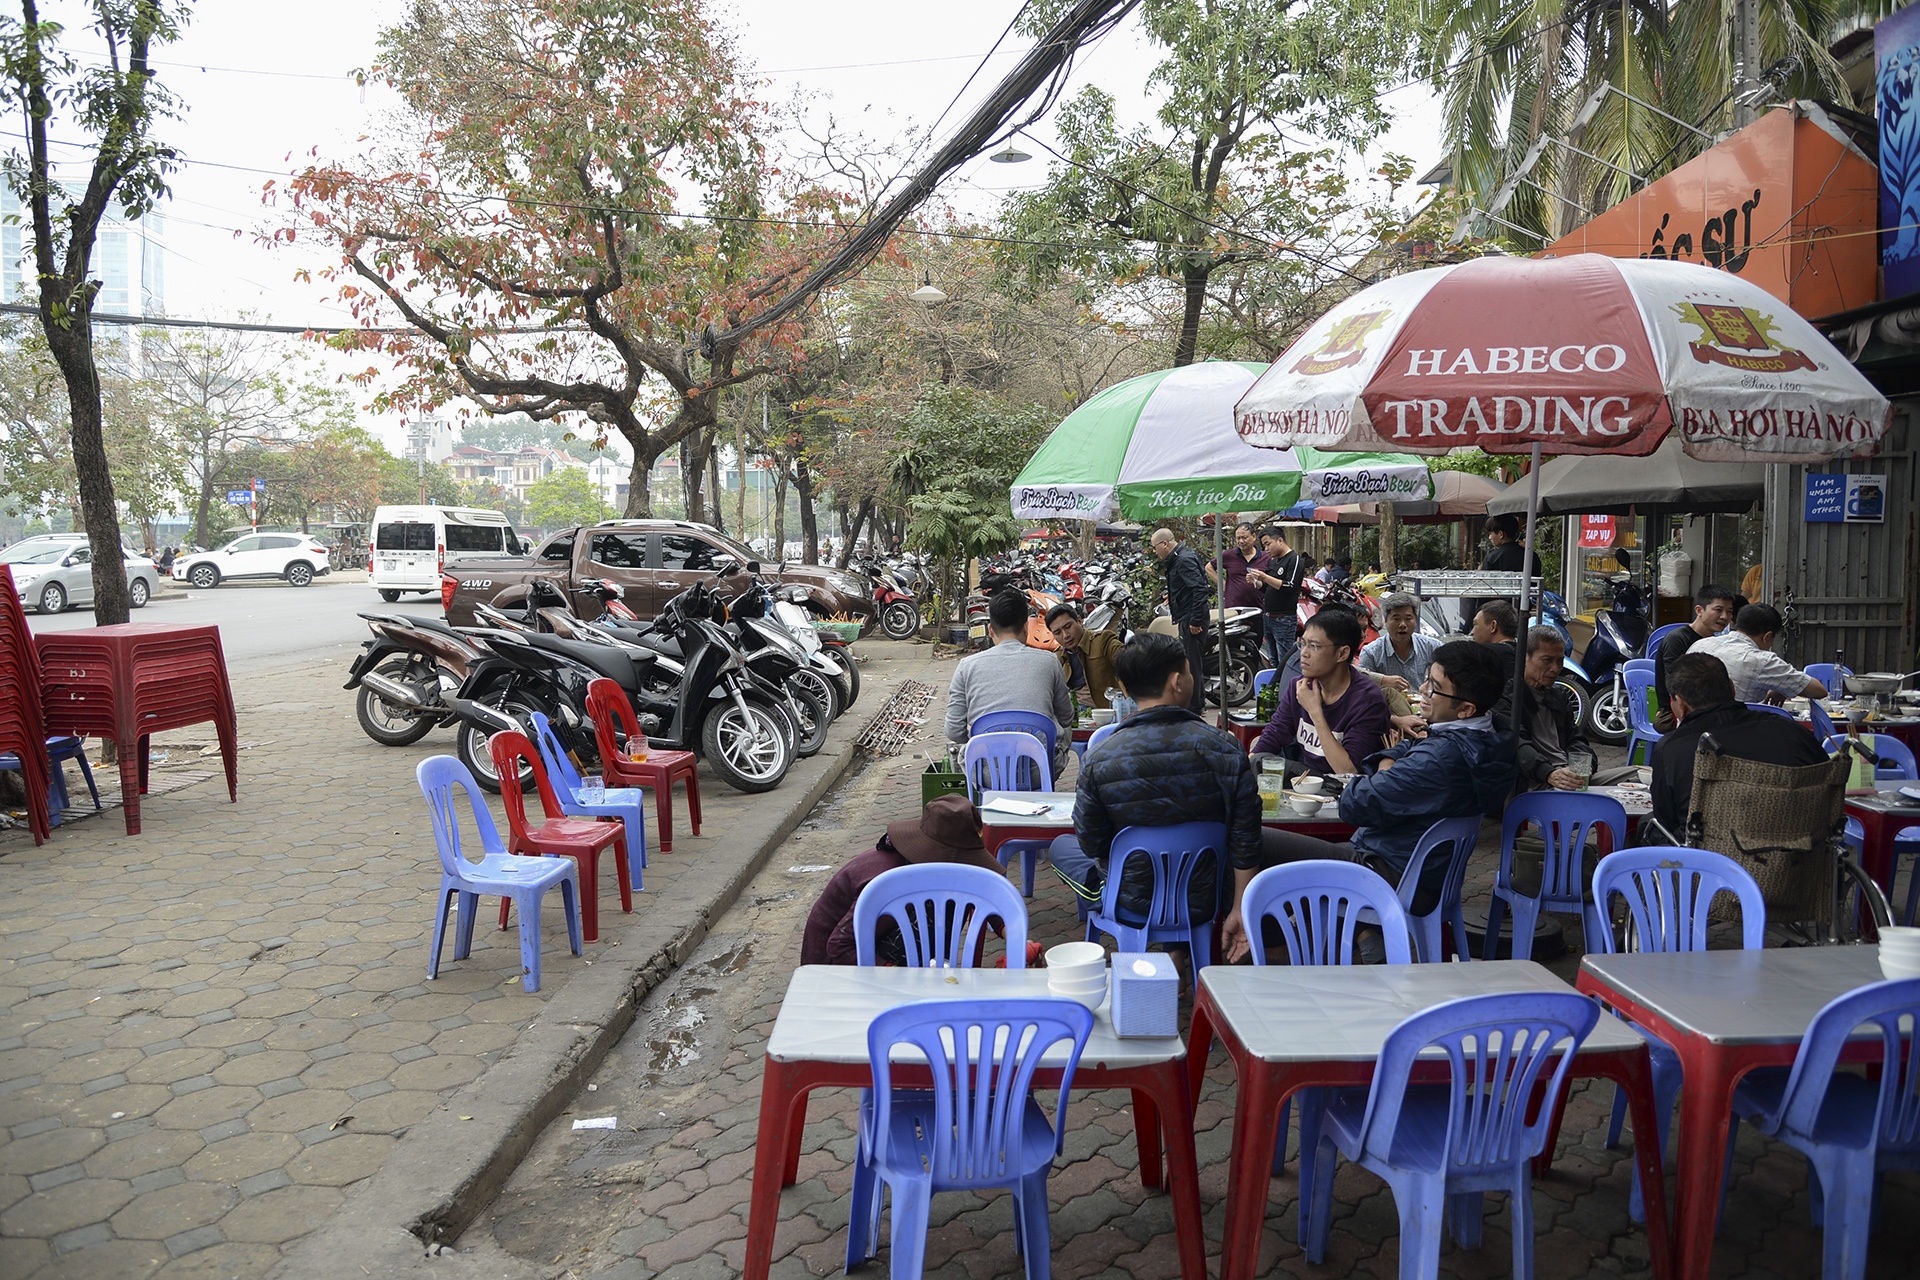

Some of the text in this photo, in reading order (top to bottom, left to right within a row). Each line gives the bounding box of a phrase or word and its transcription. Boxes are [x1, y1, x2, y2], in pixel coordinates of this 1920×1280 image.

[1304, 360, 1341, 373] HABECO
[1404, 344, 1627, 376] HABECO
[1726, 355, 1786, 371] HABECO
[1741, 374, 1801, 391] Since 1890
[1239, 411, 1265, 435] BIA
[1267, 409, 1293, 434] HƠI
[1295, 403, 1319, 435] HÀ
[1384, 396, 1632, 439] TRADING
[1682, 407, 1725, 437] BIA
[1728, 406, 1779, 438] HƠI
[1784, 404, 1823, 439] HÀ
[1322, 470, 1417, 497] Trúc Bạch Beer
[1809, 487, 1842, 496] UNLIKE
[1021, 487, 1045, 509] Trúc
[1044, 487, 1076, 511] Bạch
[1149, 483, 1267, 510] Kiệt tác Bia
[1817, 497, 1835, 505] ANY
[1811, 506, 1841, 514] OTHER
[1586, 530, 1611, 543] TẠP VỤ
[461, 579, 492, 587] 4WD
